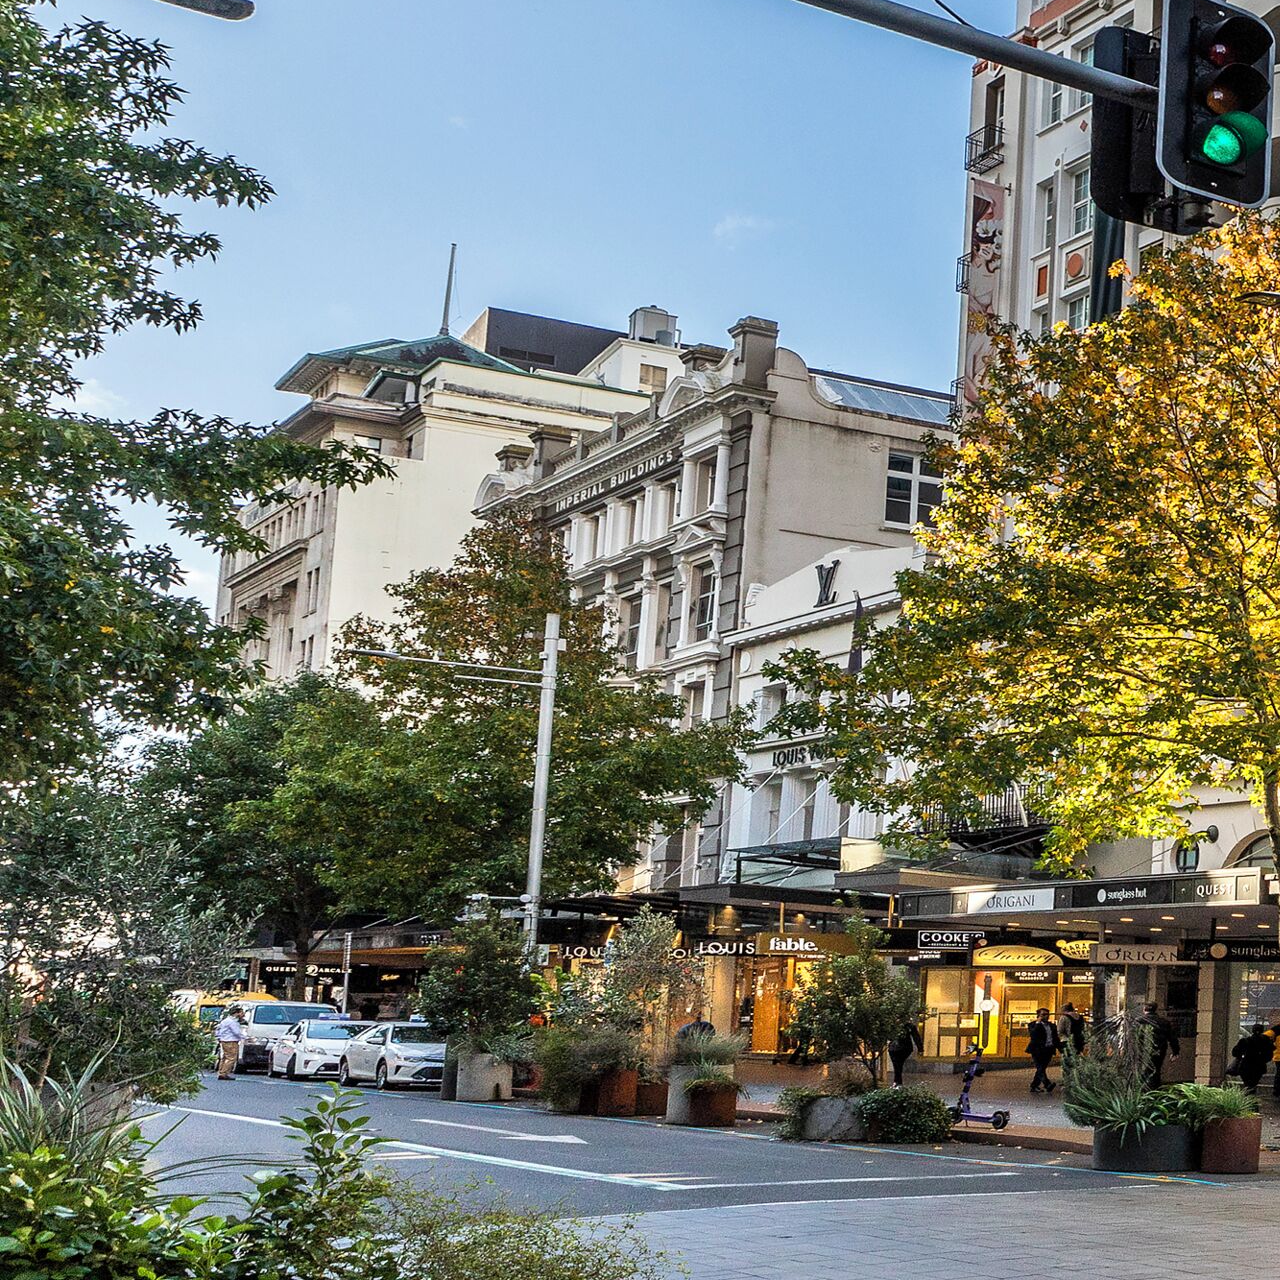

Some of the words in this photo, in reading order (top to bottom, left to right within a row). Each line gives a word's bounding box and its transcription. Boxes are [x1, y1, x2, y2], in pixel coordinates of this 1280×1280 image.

[556, 483, 605, 512] IMPERIAL
[610, 451, 673, 488] BUILDINGS
[772, 747, 807, 767] LOUIS
[1107, 888, 1135, 901] sunglass
[1135, 887, 1147, 898] hut
[1196, 884, 1233, 897] QUEST
[986, 894, 1035, 909] ORIGANI
[700, 942, 755, 955] LOUIS
[769, 937, 819, 952] fable.
[1106, 947, 1179, 962] ORIGAN
